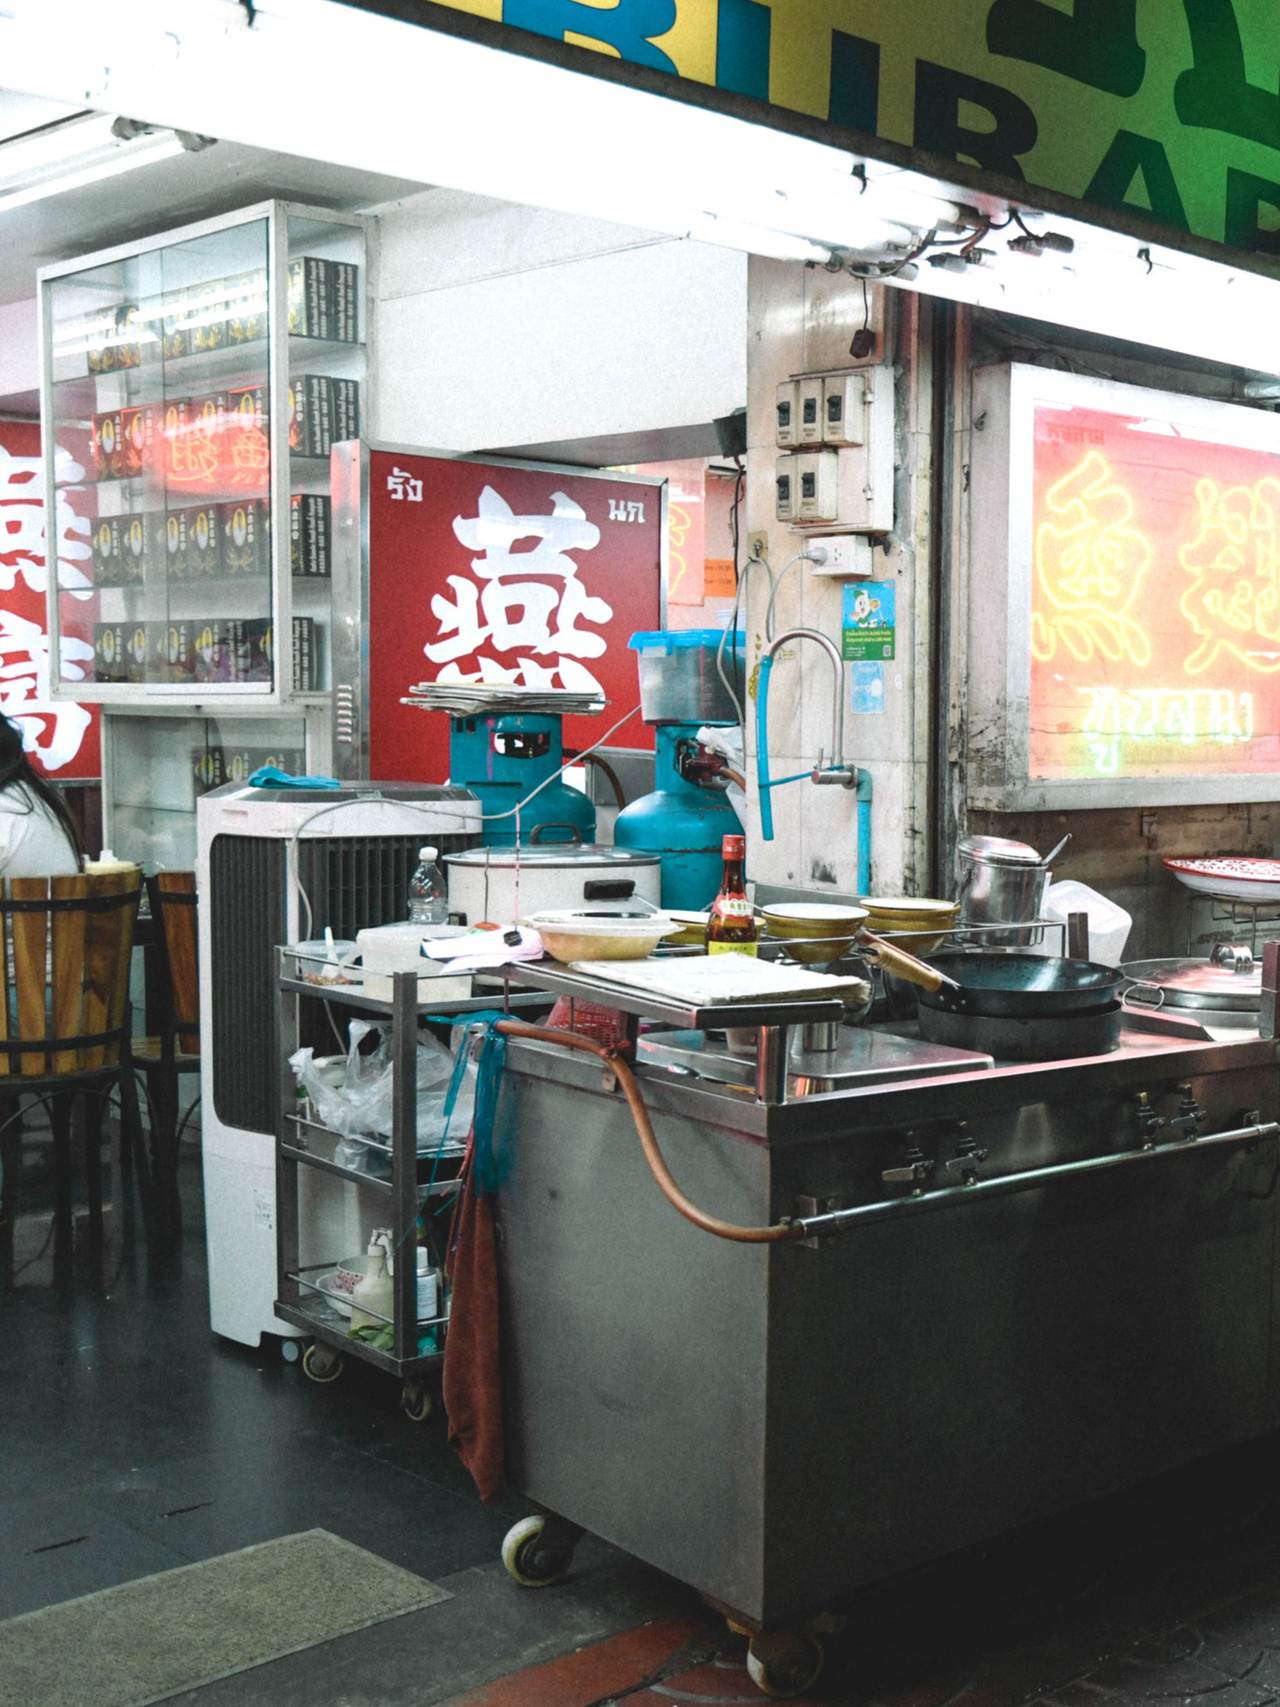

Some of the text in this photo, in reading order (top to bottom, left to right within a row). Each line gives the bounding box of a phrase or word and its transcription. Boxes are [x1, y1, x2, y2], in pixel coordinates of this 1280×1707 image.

[387, 466, 424, 502] รัง
[608, 498, 646, 523] นก
[423, 485, 613, 702] 燕
